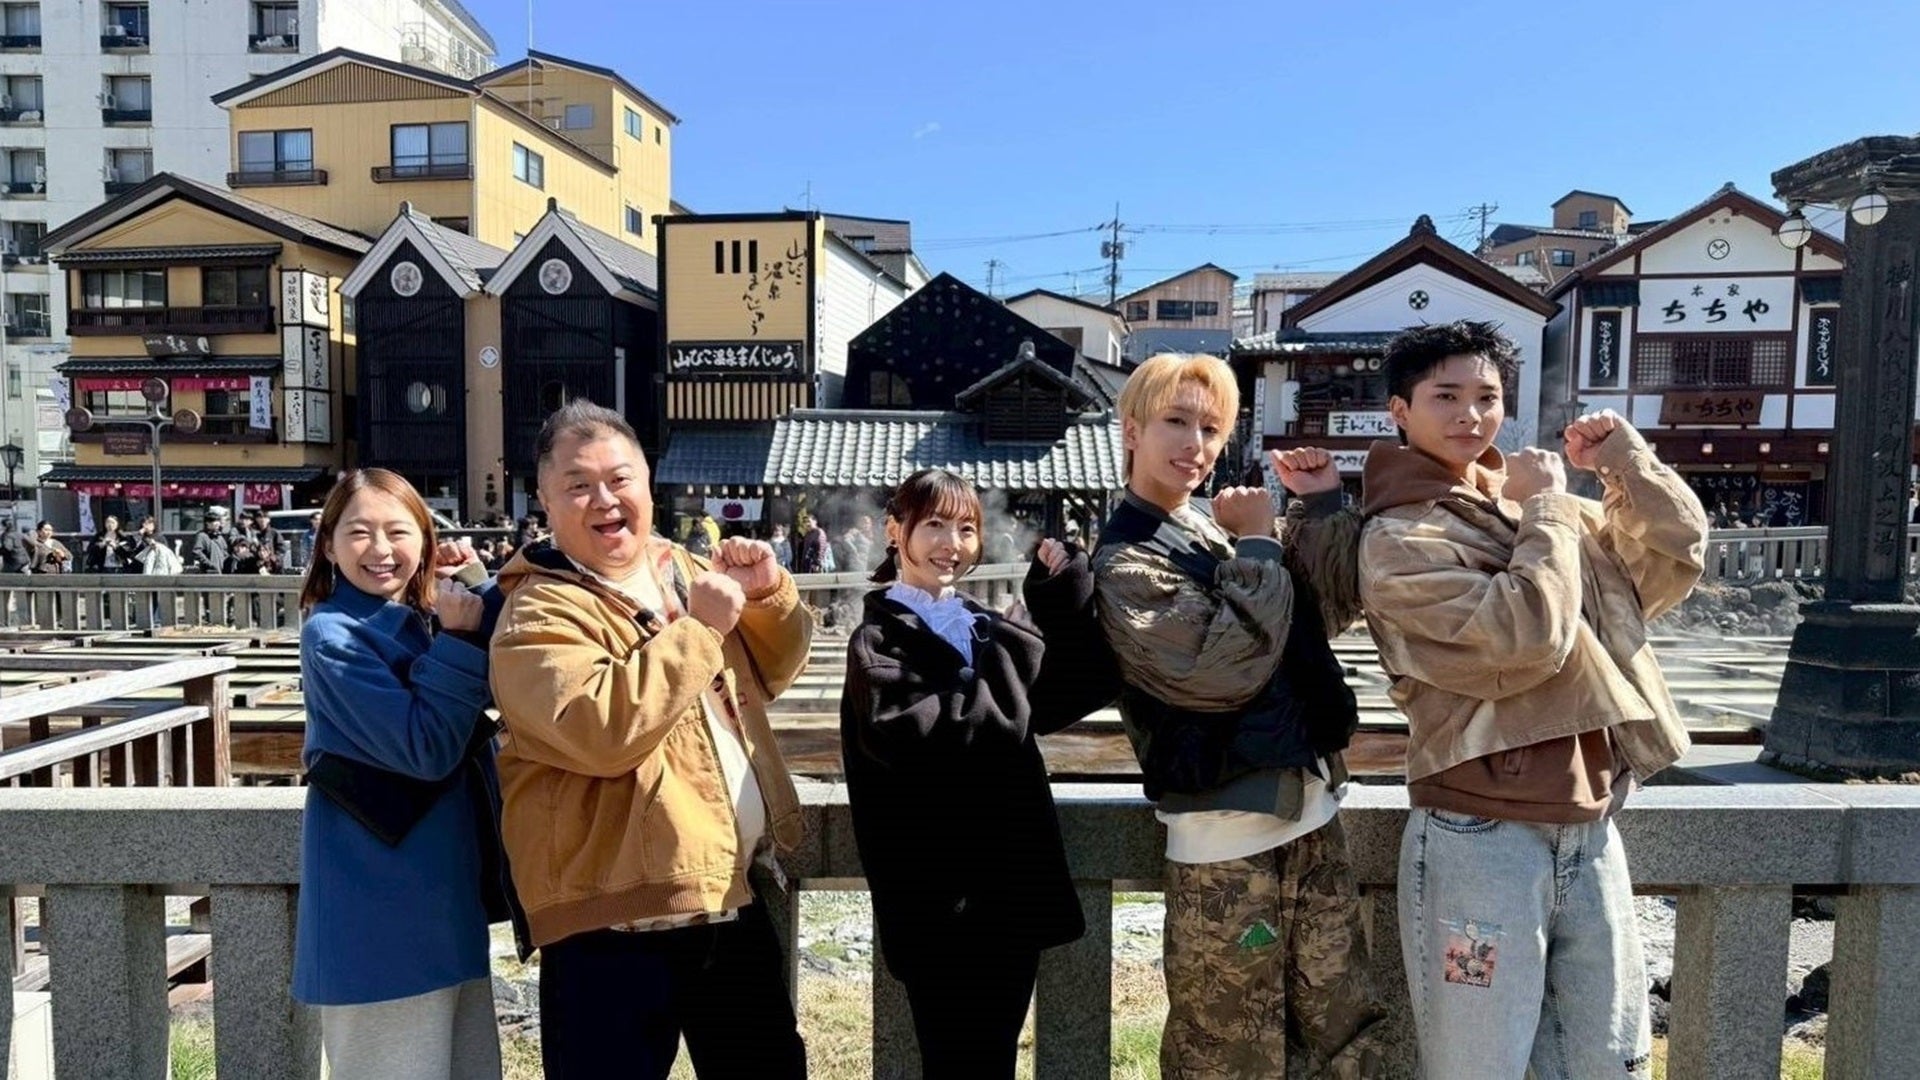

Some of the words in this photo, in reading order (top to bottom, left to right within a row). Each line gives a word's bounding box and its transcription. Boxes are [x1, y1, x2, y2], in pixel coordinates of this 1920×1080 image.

[764, 261, 784, 300] 温泉
[1690, 284, 1740, 298] 本家
[1661, 298, 1770, 323] ちちや
[673, 345, 797, 369] 山びこ温泉まんじゅう
[1695, 398, 1754, 417] ちちや
[1332, 414, 1393, 434] まんてん
